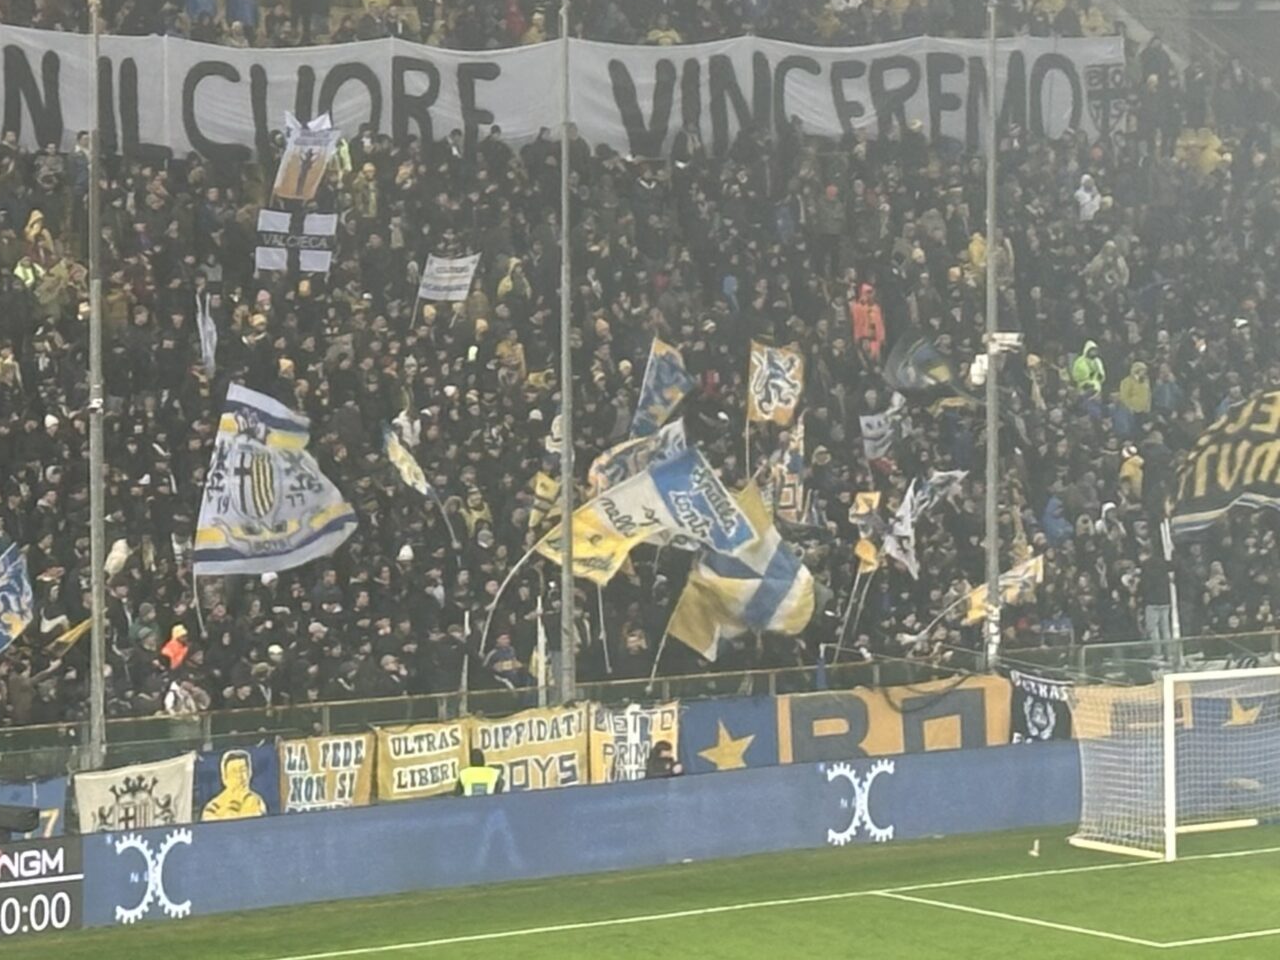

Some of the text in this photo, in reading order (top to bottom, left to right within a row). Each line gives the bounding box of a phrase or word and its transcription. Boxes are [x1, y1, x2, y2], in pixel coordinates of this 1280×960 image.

[98, 55, 174, 162] IL
[390, 727, 462, 757] ULTRAS
[480, 710, 583, 751] DIFFIDATI
[286, 739, 365, 772] LA FEDE
[602, 742, 650, 767] PRIM
[290, 771, 356, 803] NON SI
[396, 761, 458, 790] LIBERI
